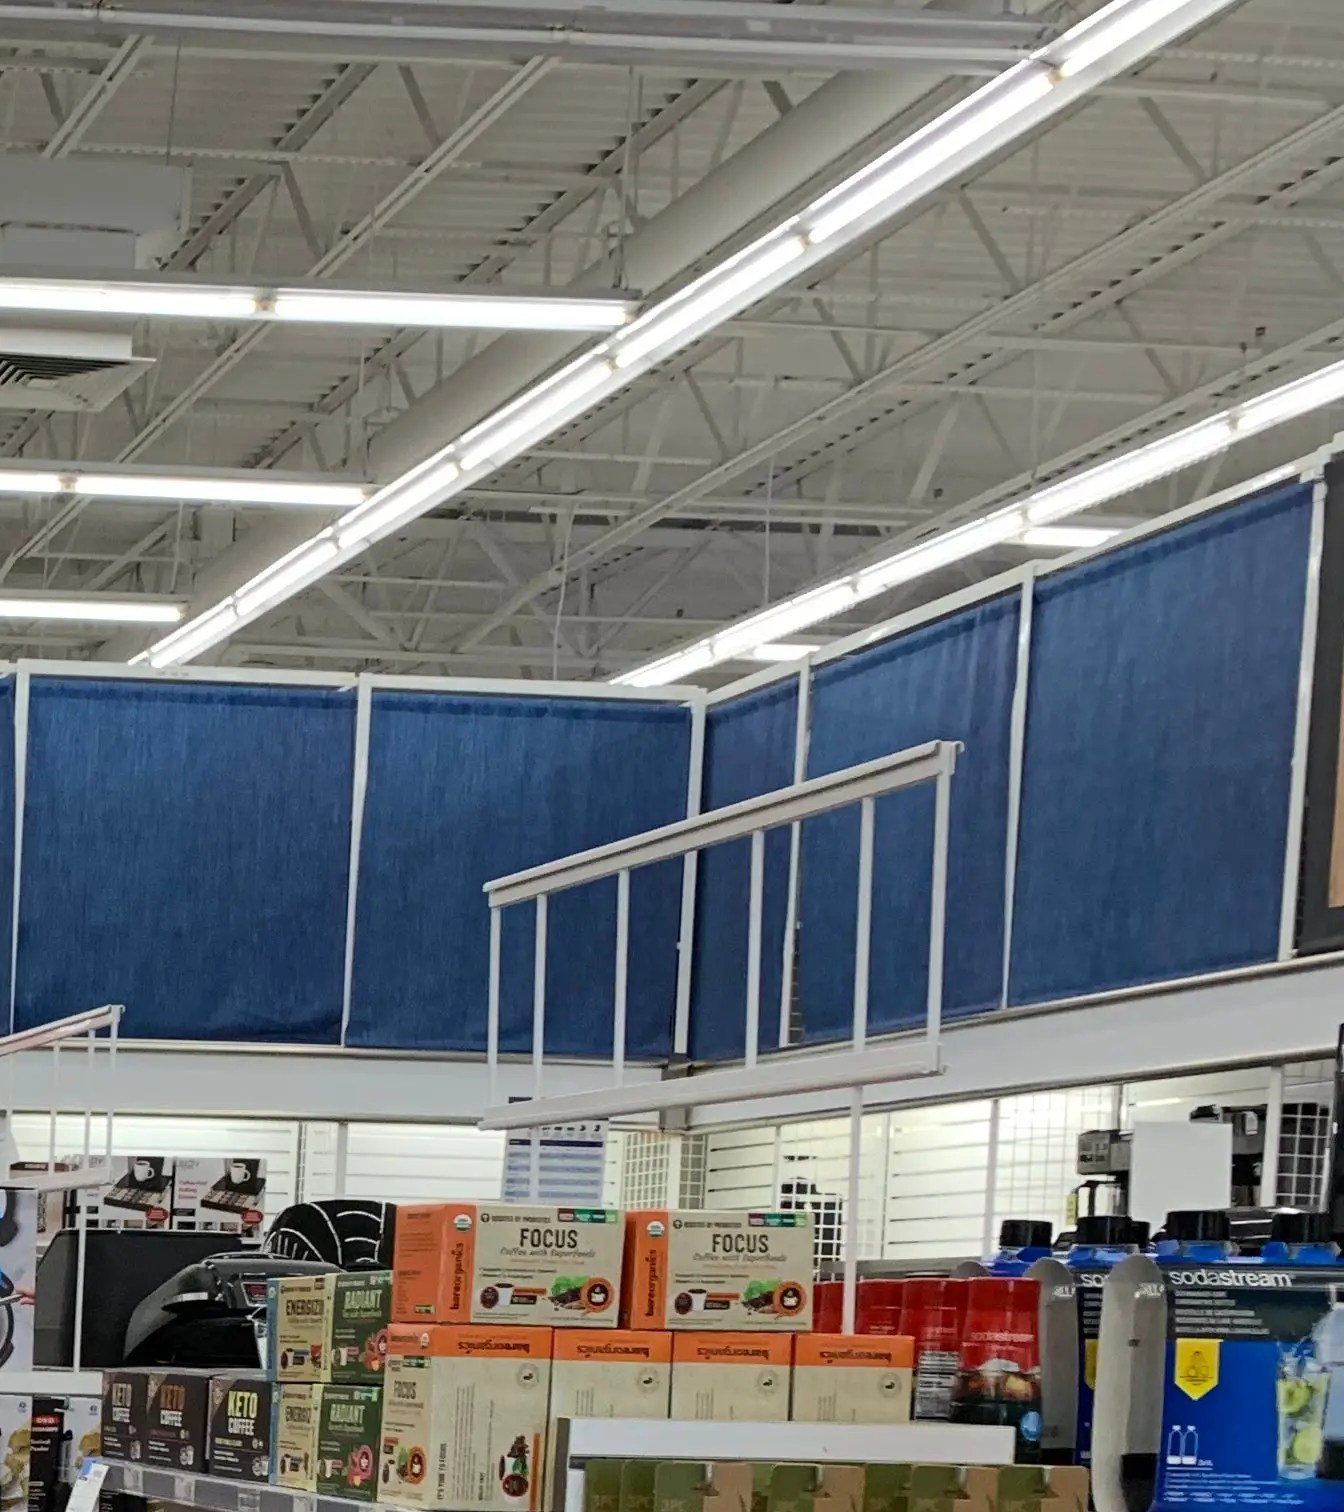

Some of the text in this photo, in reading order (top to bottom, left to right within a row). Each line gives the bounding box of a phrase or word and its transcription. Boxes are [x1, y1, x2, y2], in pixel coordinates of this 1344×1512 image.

[520, 1228, 578, 1248] FOCUS
[712, 1234, 769, 1253] FOCUS
[1171, 1268, 1293, 1288] sodastream
[228, 1391, 258, 1418] KETO
[228, 1418, 255, 1436] COFFEE
